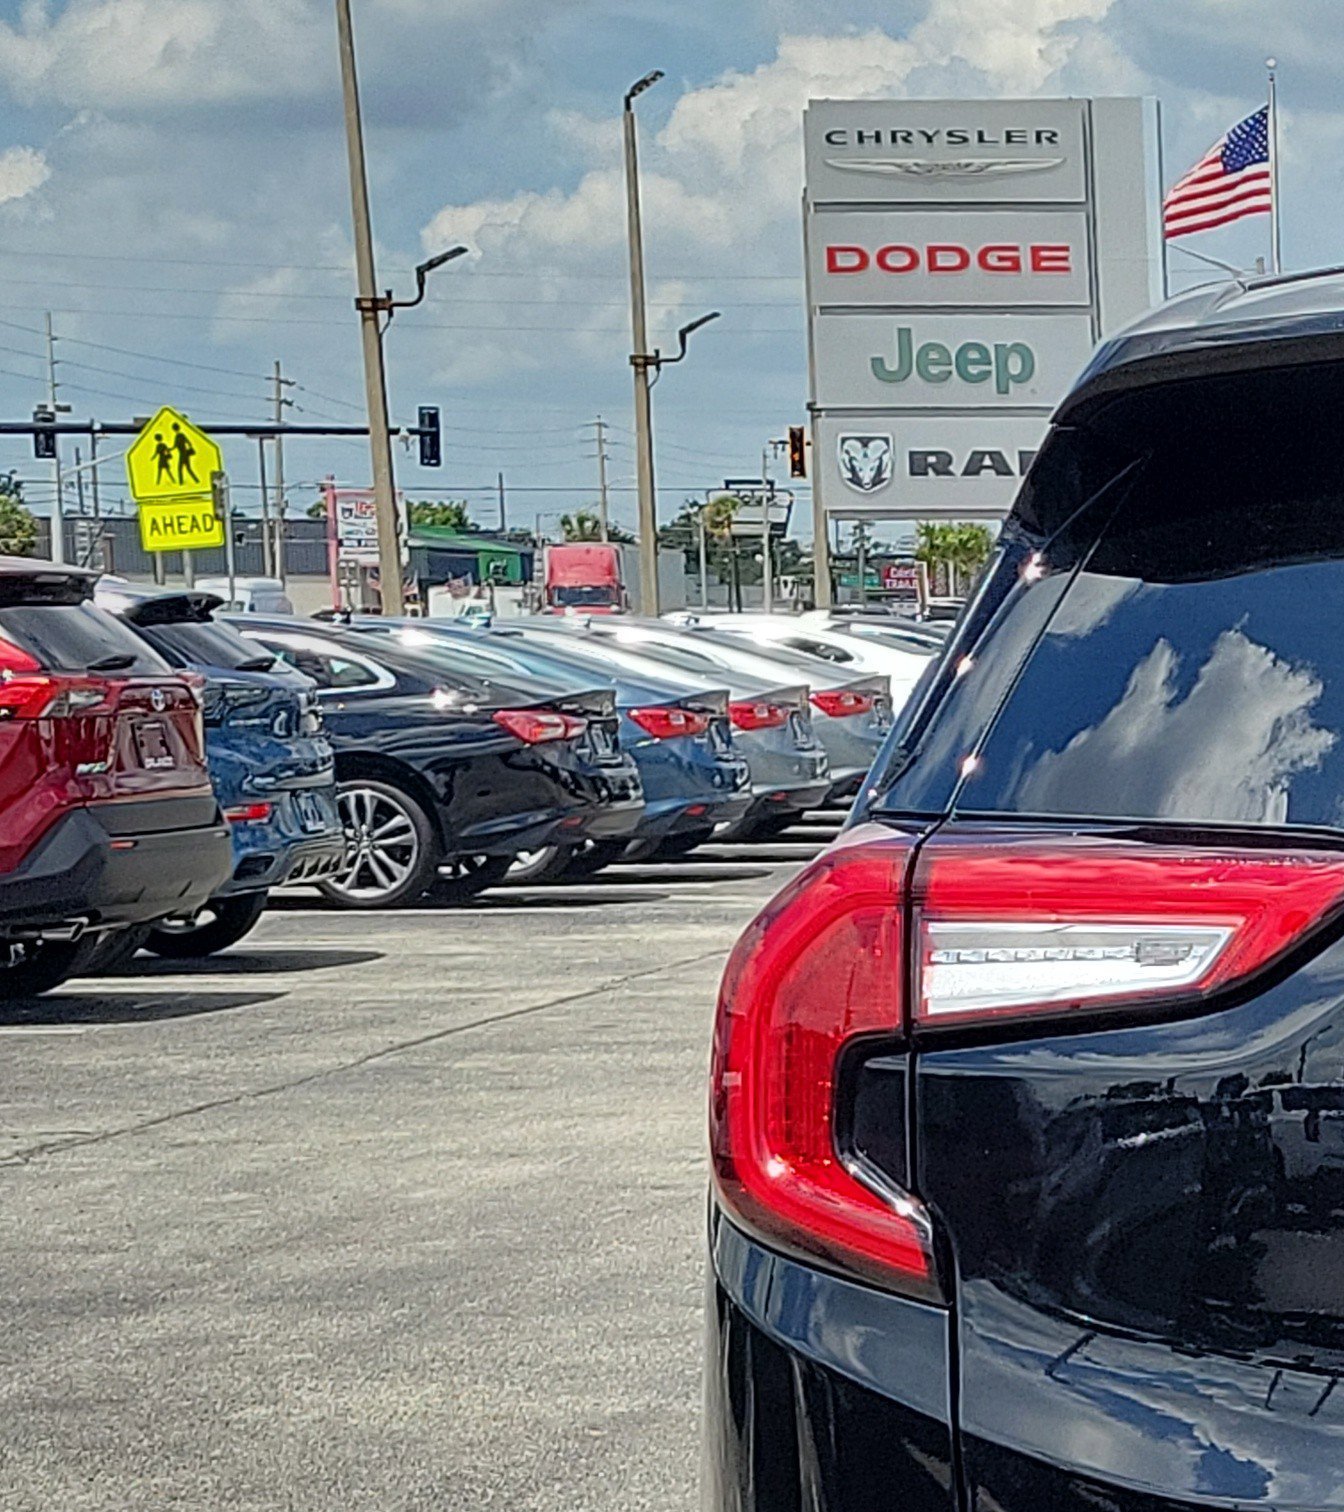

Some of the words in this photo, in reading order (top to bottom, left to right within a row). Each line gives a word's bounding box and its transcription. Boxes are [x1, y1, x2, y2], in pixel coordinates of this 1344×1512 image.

[824, 129, 1060, 146] CHRYSLER
[826, 244, 1072, 274] DODGE
[870, 327, 1036, 395] Jeep
[149, 513, 215, 537] AHEAD
